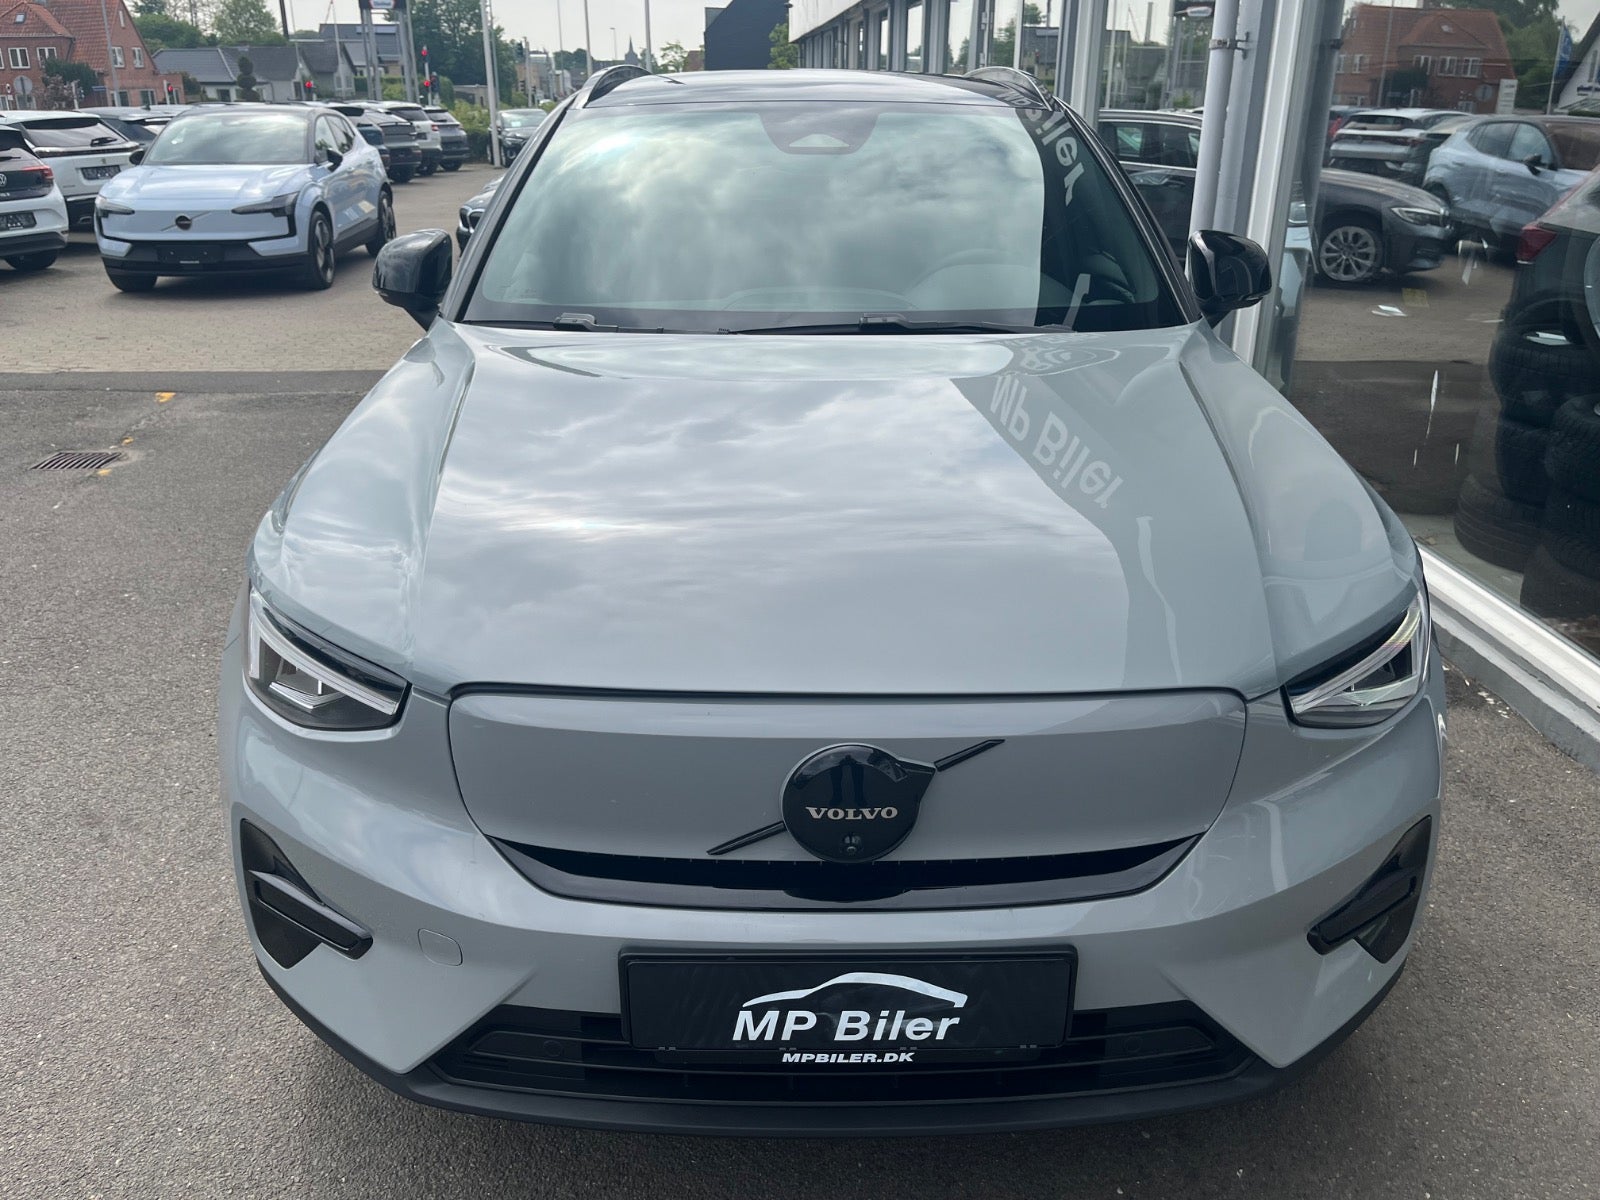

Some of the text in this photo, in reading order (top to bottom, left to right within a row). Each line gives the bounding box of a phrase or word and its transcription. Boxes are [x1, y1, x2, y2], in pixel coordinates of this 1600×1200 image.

[805, 806, 898, 820] VOLVO
[732, 1010, 961, 1041] MP Biler
[782, 1052, 915, 1063] MPBILER.DK
